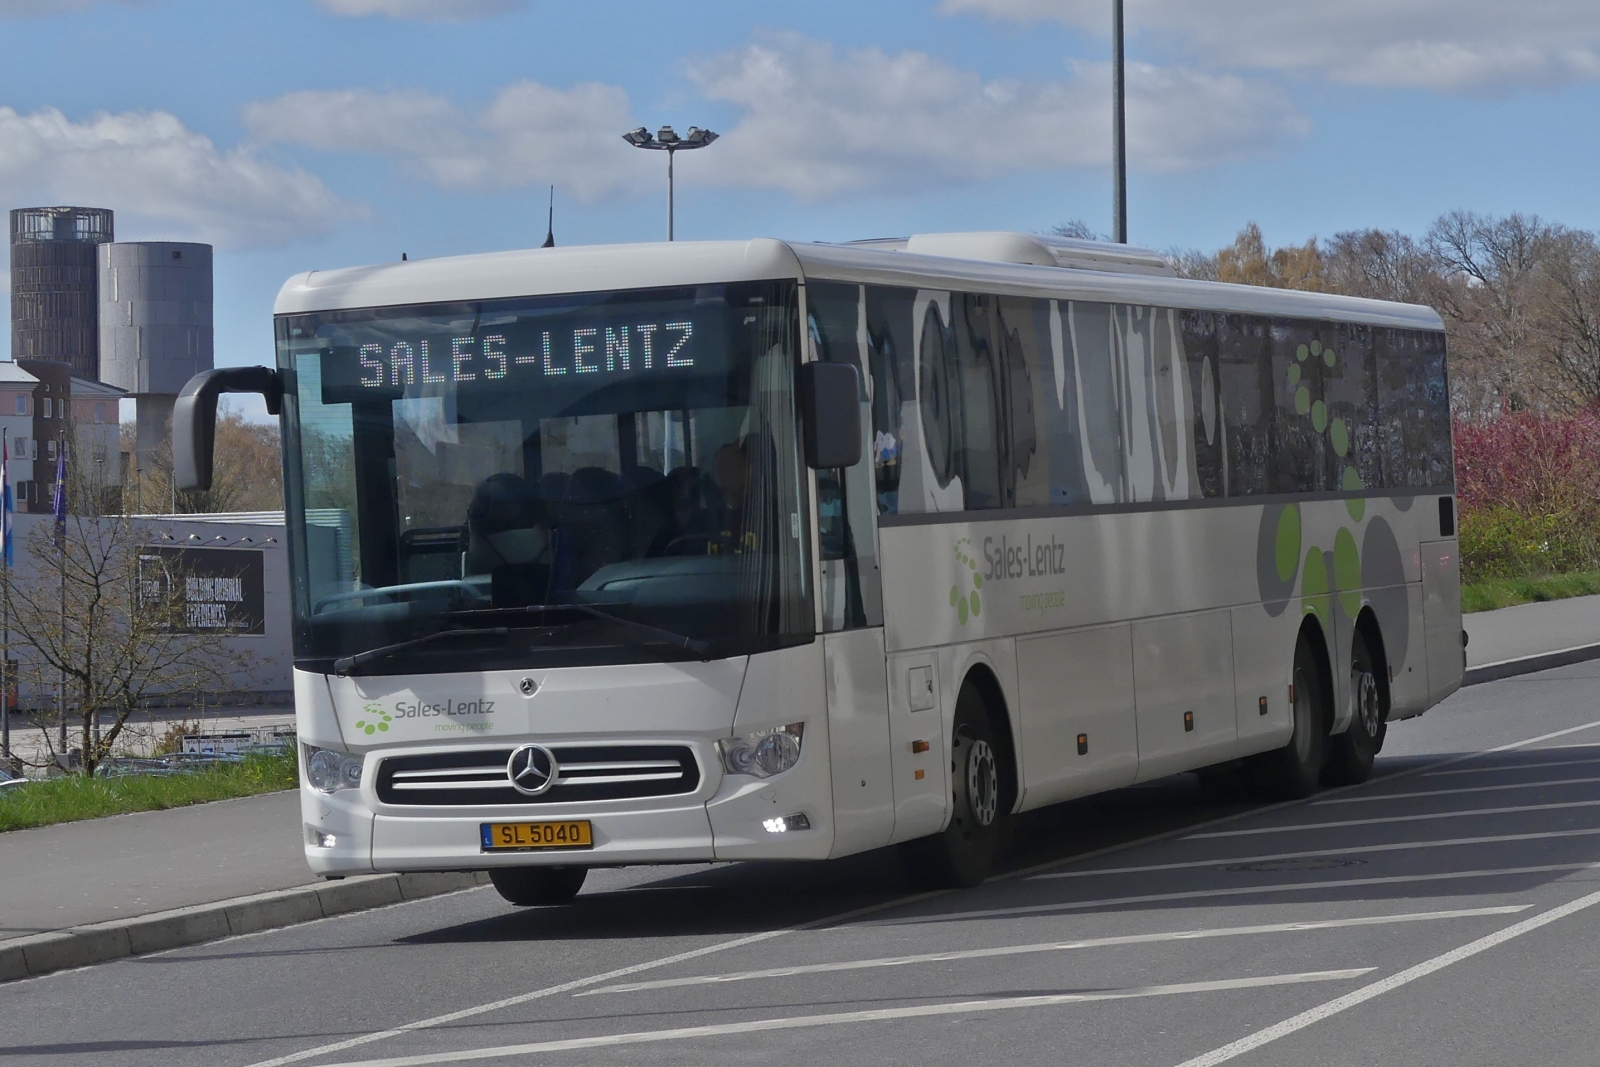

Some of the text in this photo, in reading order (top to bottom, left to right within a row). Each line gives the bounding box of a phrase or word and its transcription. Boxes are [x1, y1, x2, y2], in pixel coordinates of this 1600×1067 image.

[359, 321, 694, 388] SALES-LENTZ
[984, 533, 1065, 581] Sales-Lentz
[186, 577, 214, 602] BUILDING
[214, 577, 243, 602] ORIGINAL
[1044, 588, 1065, 611] people
[186, 603, 227, 628] EXPERIENCES
[394, 698, 495, 719] Sales-Lentz
[434, 721, 494, 733] moving people
[501, 824, 580, 844] SL 5040
